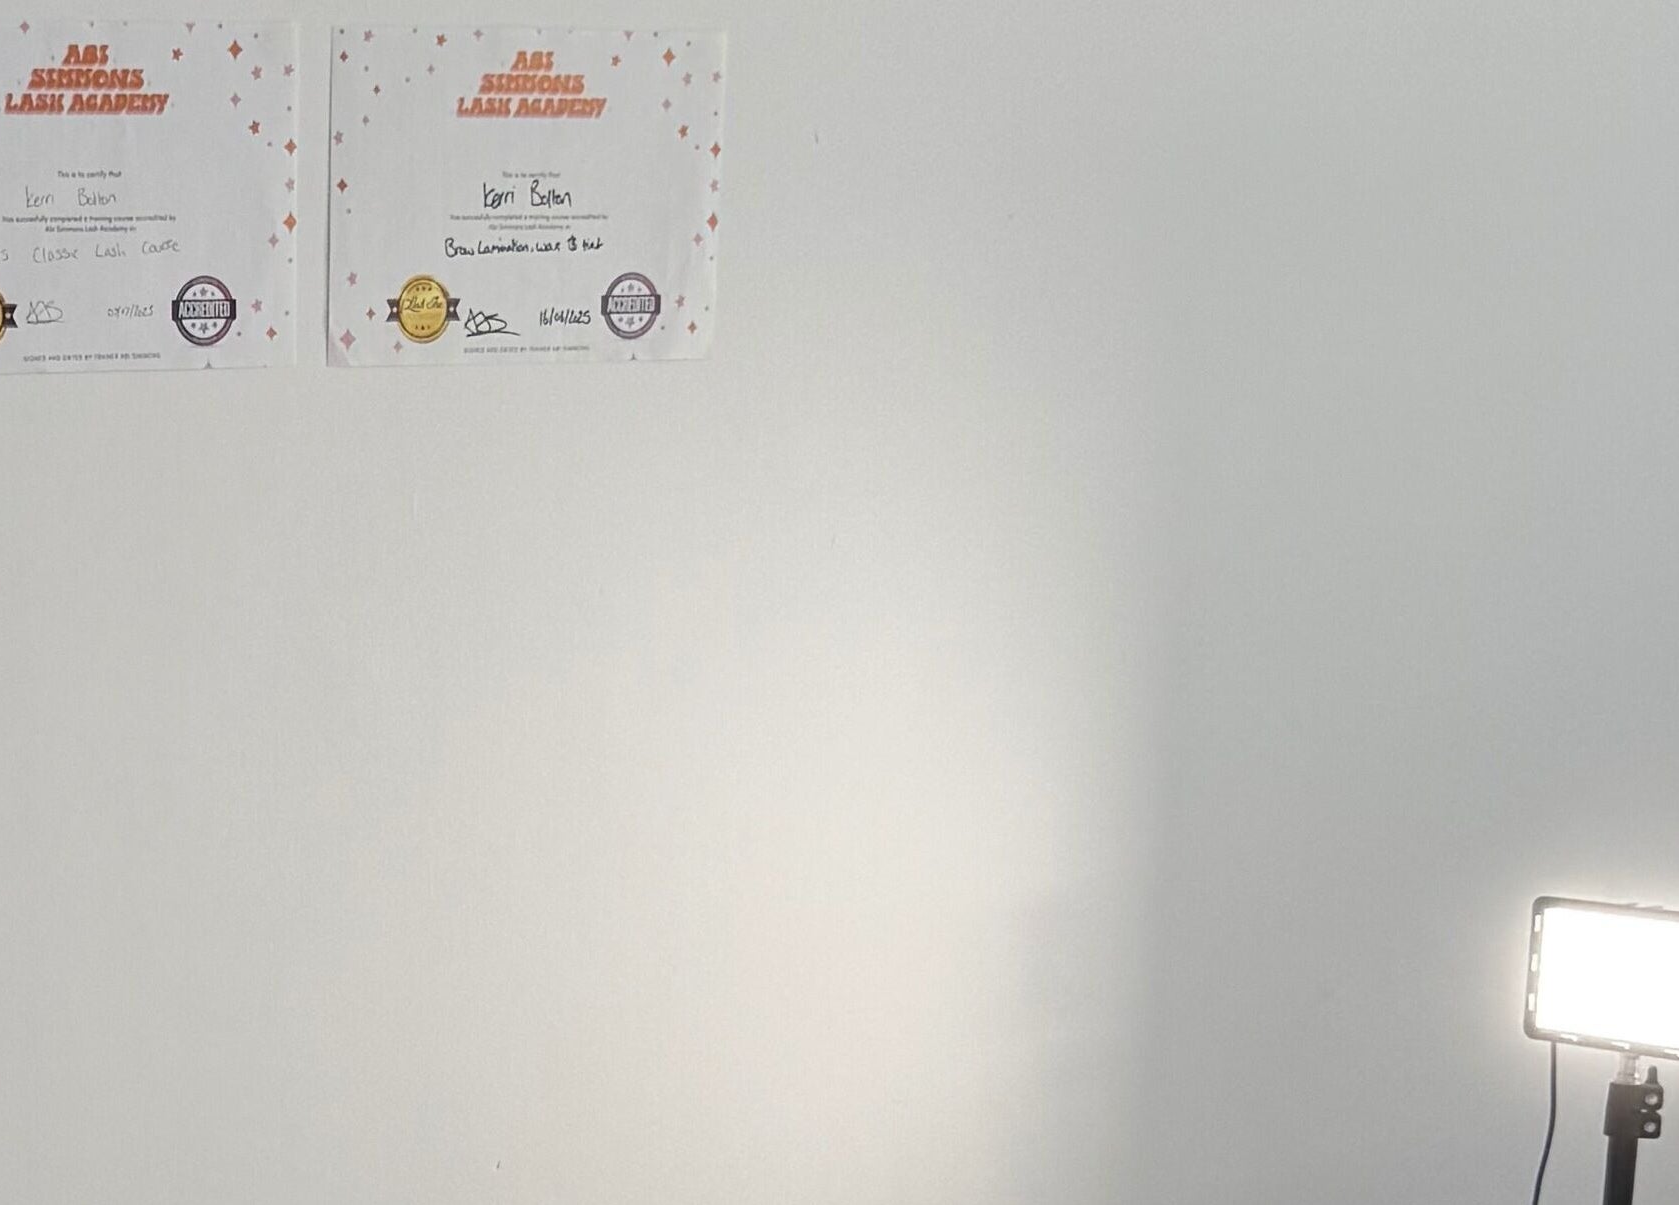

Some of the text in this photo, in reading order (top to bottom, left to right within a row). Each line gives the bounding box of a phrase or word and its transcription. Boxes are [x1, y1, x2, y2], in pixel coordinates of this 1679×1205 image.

[62, 44, 110, 66] ABI
[510, 50, 555, 72] ABI
[27, 68, 145, 91] SIMMONS
[478, 73, 585, 95] SIMMONS
[4, 93, 170, 115] LASH ACADEMY
[456, 96, 607, 118] LASH ACADEMY
